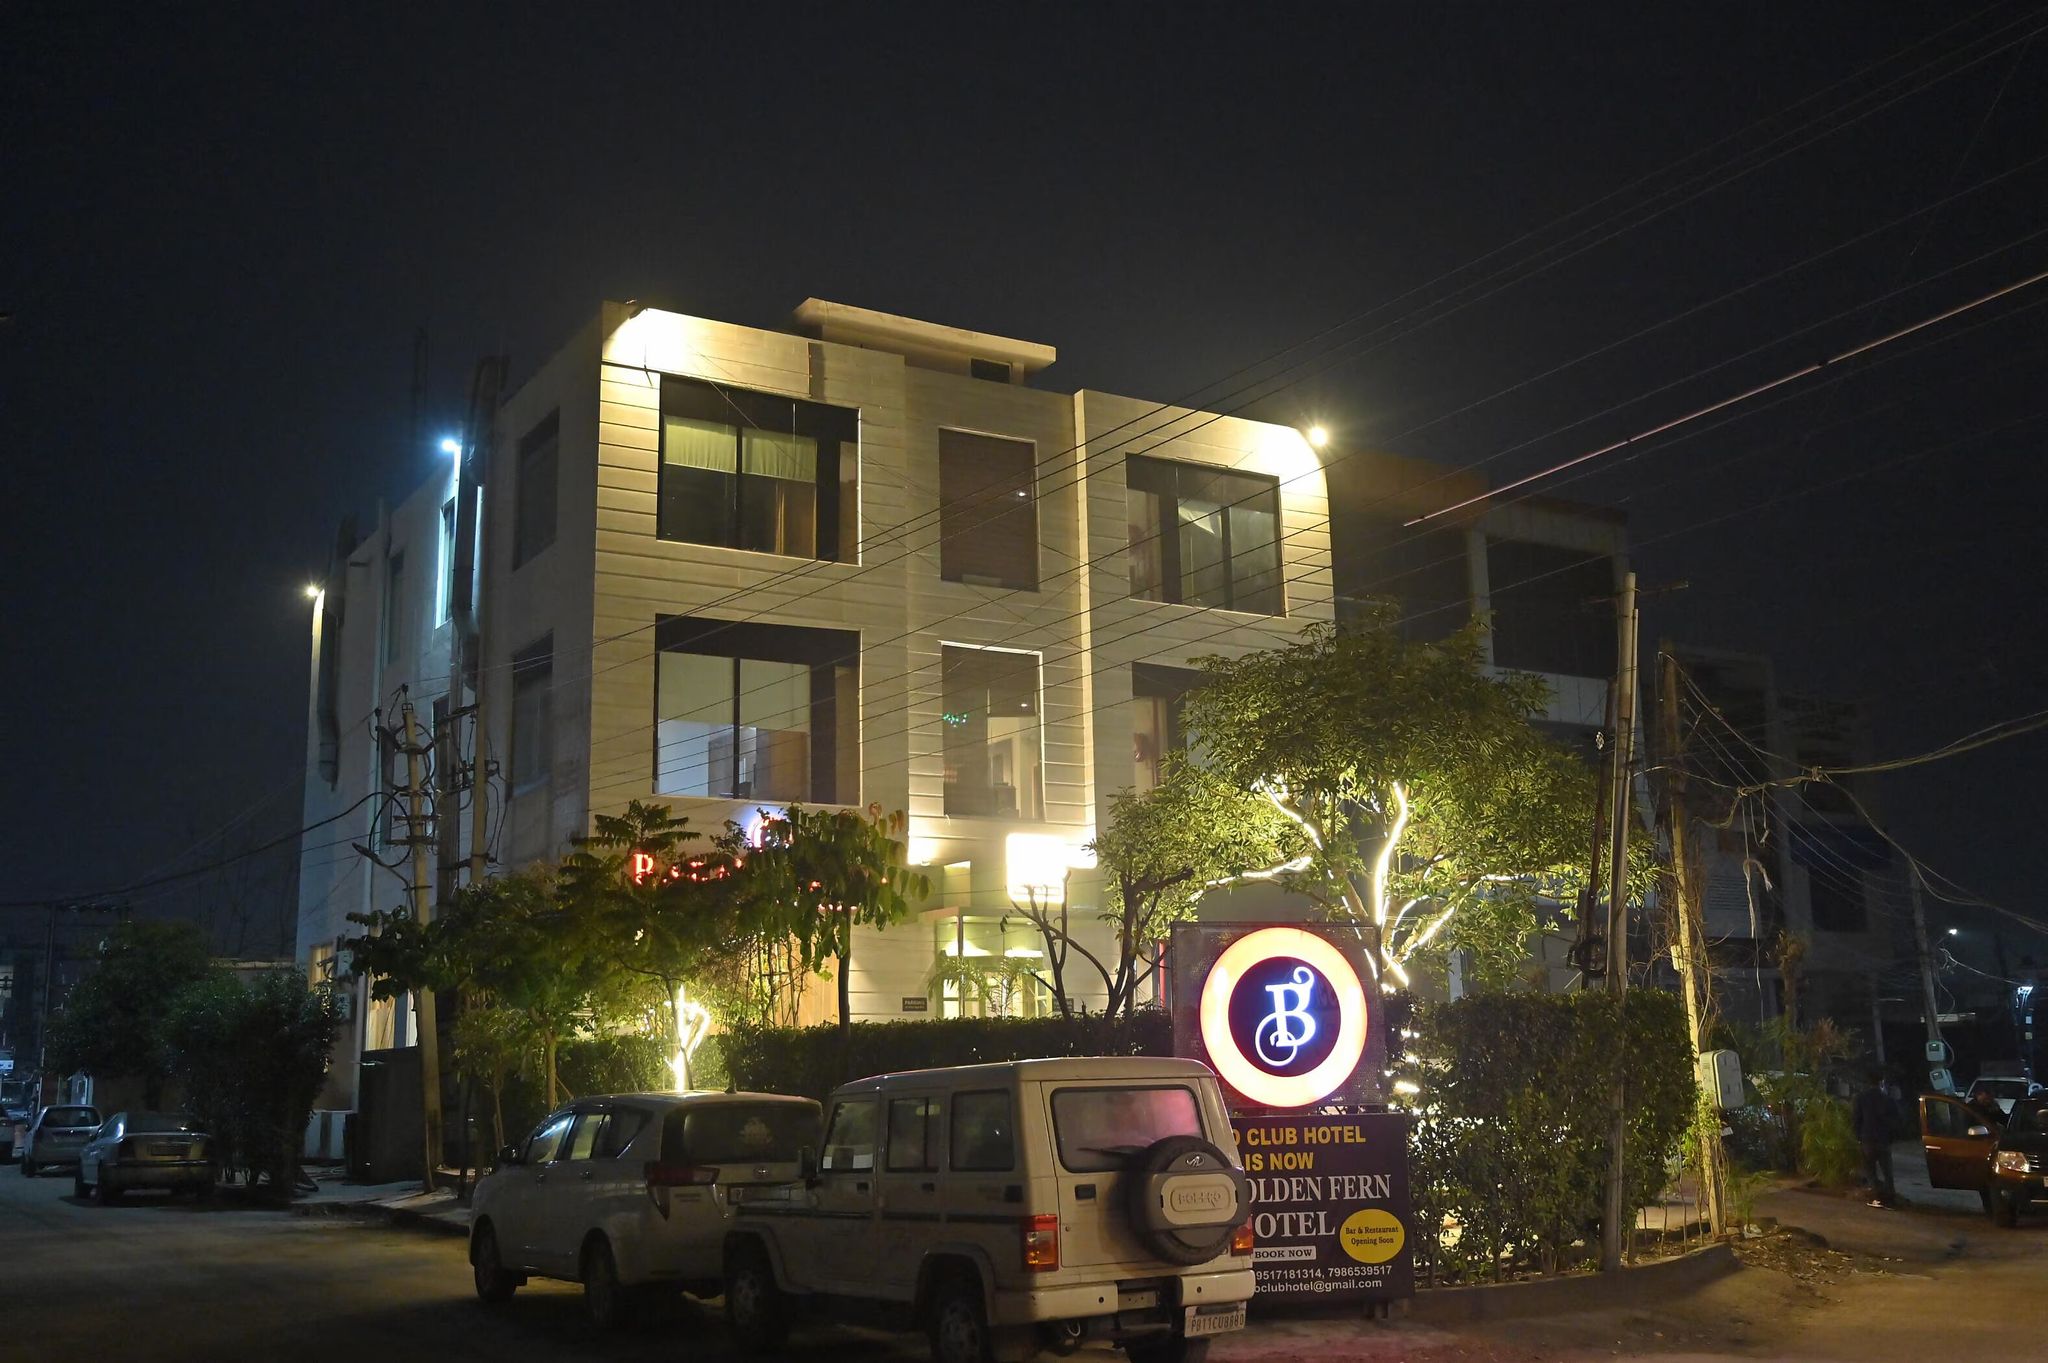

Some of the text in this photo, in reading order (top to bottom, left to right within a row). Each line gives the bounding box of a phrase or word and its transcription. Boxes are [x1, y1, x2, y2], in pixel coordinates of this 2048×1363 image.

[1247, 1127, 1298, 1146] CLUB
[1304, 1125, 1367, 1145] HOTEL
[1245, 1152, 1314, 1171] IS NOW
[1246, 1174, 1391, 1203] OLDEN FERN
[1251, 1211, 1336, 1238] OTEL
[1345, 1226, 1399, 1235] Bar & Restaurant
[1351, 1237, 1378, 1247] Opening
[1254, 1248, 1313, 1259] BOOK NOW
[1328, 1265, 1392, 1278] 7986539517
[1254, 1279, 1382, 1294] oclubhotel@gmail.com
